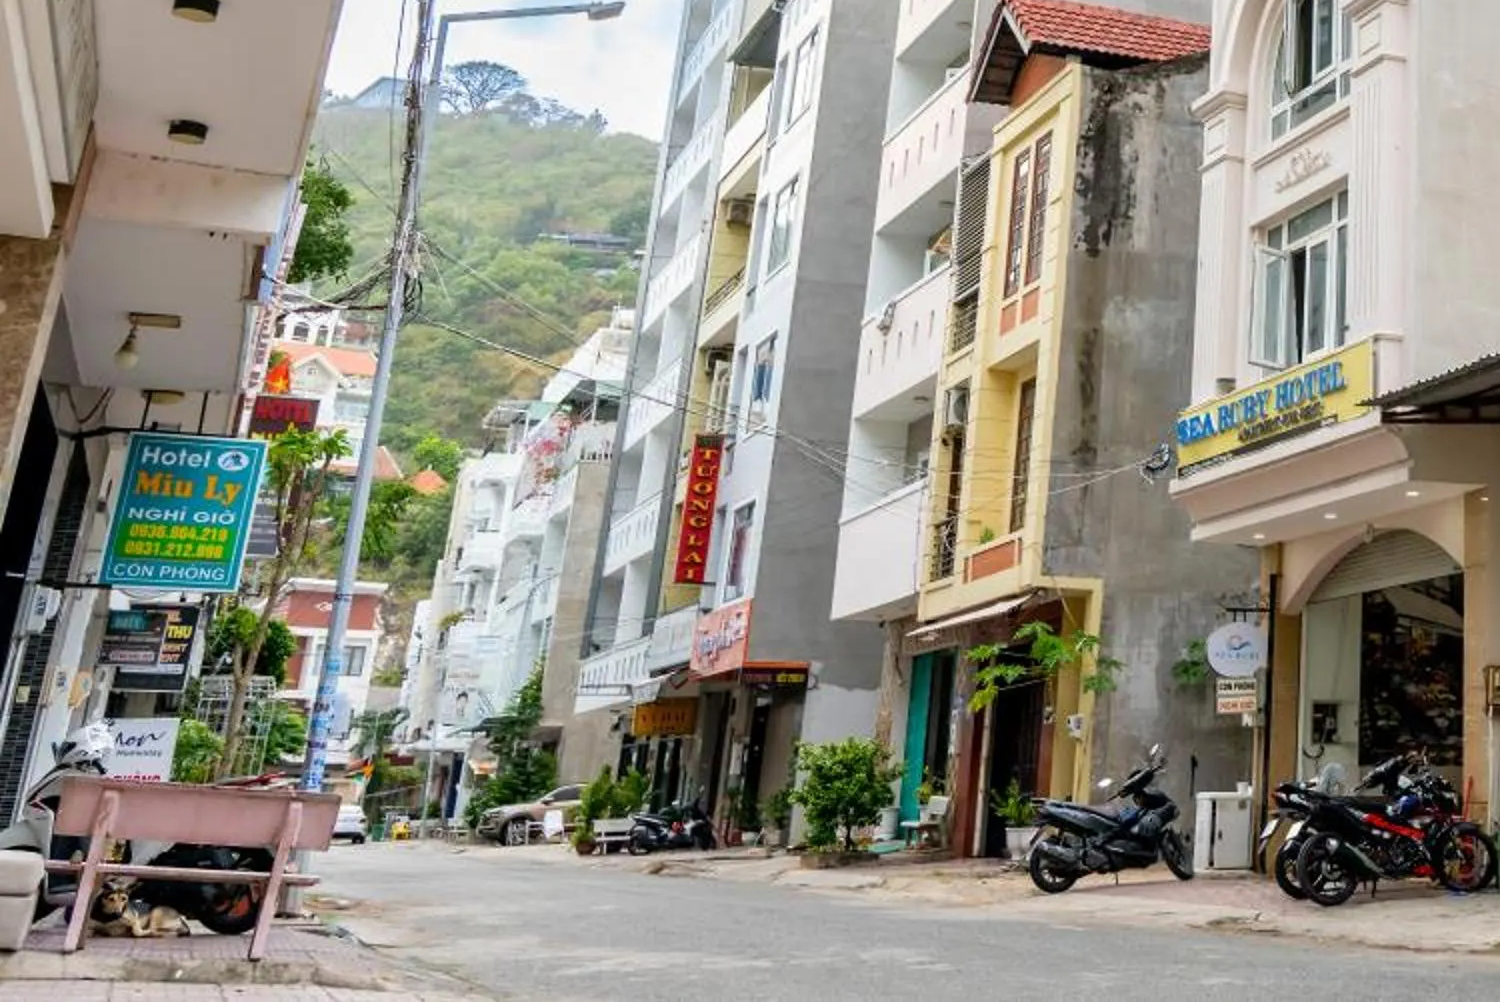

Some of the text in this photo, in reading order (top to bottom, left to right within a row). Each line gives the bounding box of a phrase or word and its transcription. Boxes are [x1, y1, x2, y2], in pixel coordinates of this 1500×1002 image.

[1176, 408, 1218, 444] SEA
[1275, 362, 1345, 411] HOTEL
[141, 447, 212, 468] Hotel
[204, 475, 242, 508] Ly
